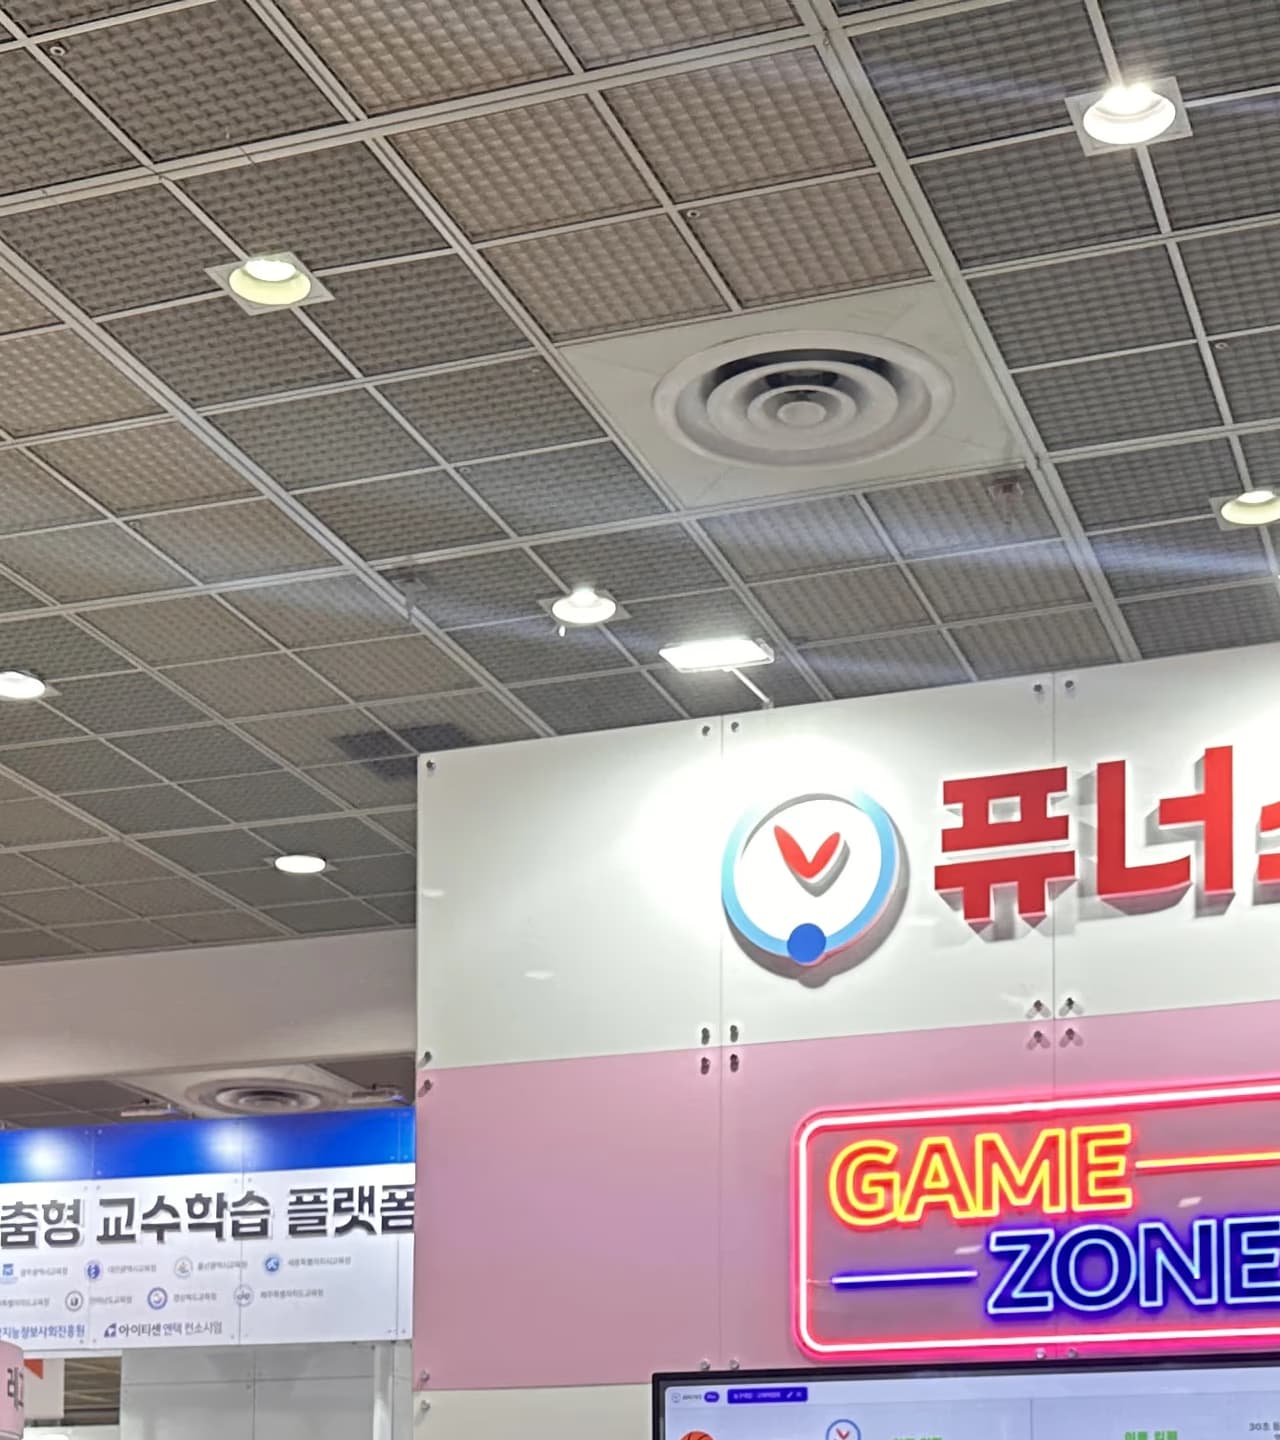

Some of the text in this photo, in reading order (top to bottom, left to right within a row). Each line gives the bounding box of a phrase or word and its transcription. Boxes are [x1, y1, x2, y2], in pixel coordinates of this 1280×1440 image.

[95, 1189, 272, 1243] 교수학습
[286, 1184, 416, 1236] 플랫폼
[827, 1122, 1133, 1228] GAME
